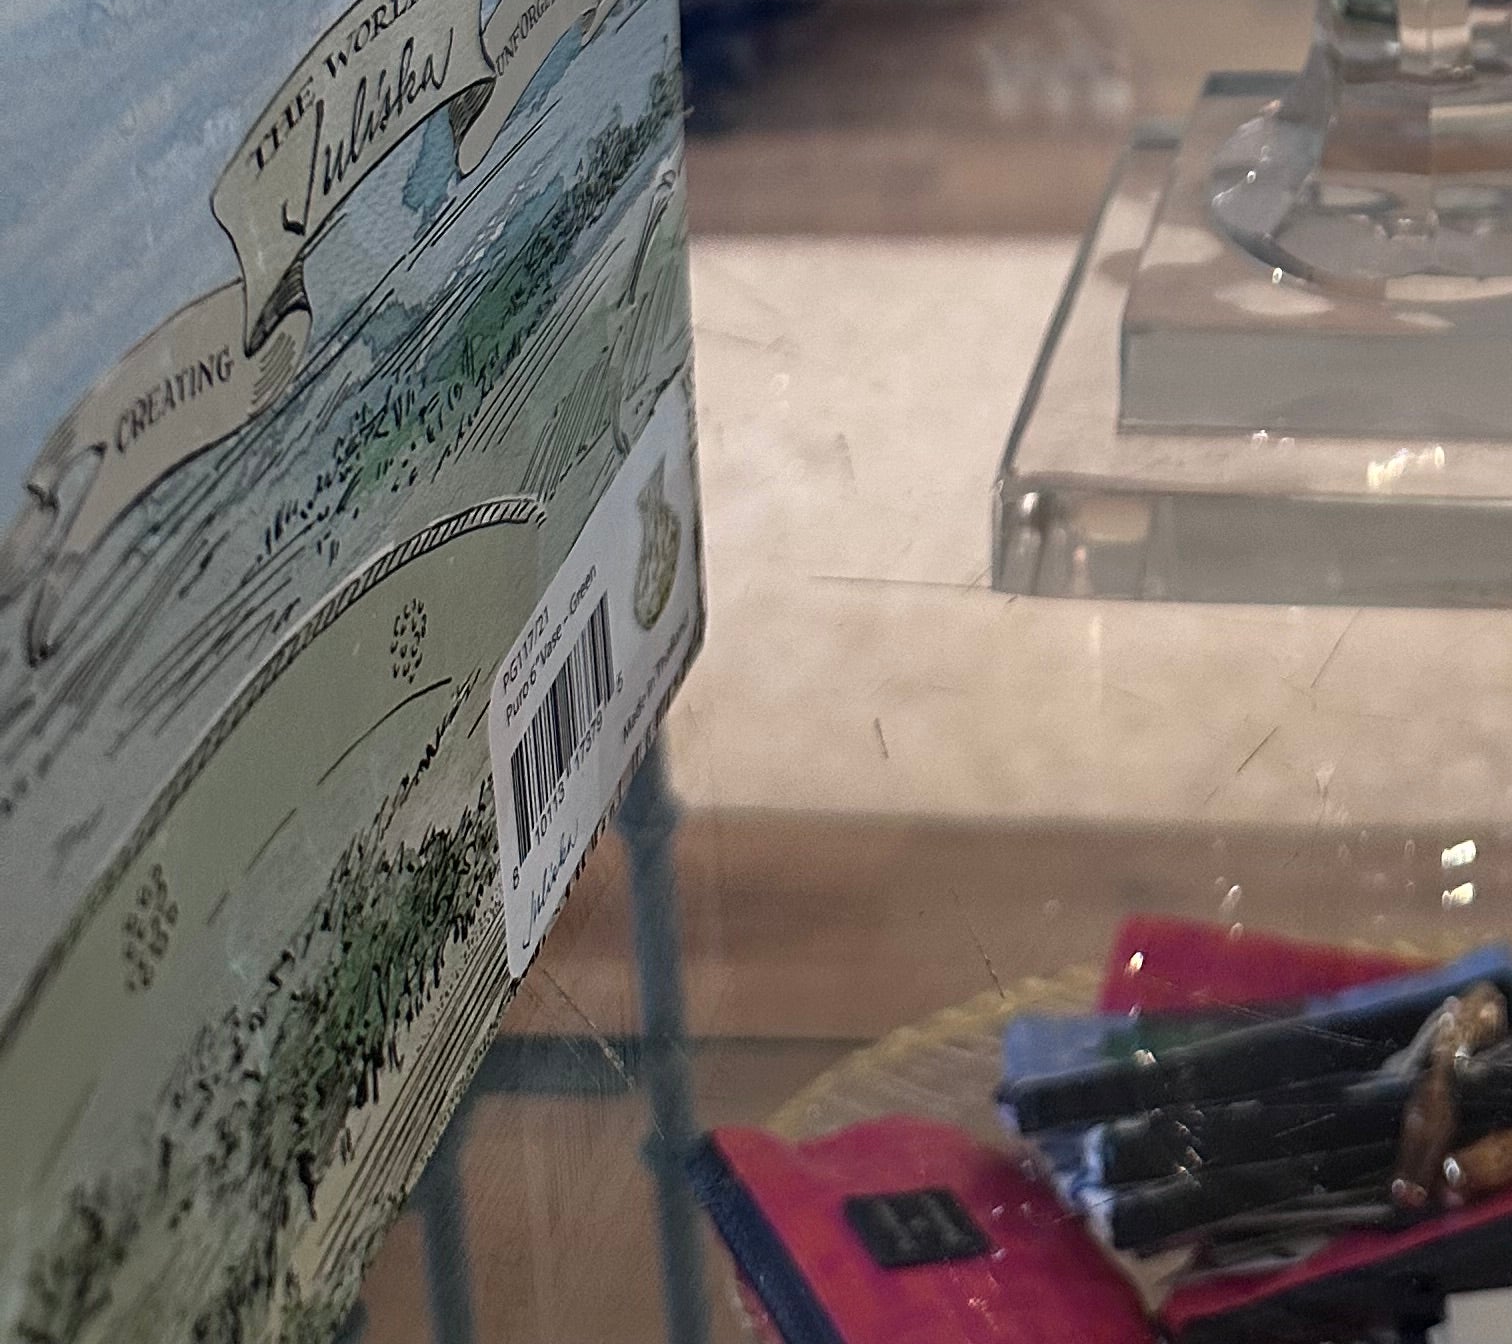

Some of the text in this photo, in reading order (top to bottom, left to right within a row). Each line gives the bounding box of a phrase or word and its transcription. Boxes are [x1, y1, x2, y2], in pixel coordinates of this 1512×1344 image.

[248, 75, 317, 179] THE
[282, 26, 454, 237] Juliska
[115, 343, 235, 454] CREATING
[502, 604, 550, 695] PG117/21
[505, 680, 530, 728] Puro
[540, 623, 563, 666] Vase
[569, 564, 597, 615] Green
[512, 669, 624, 891] 8 10113 17379 5
